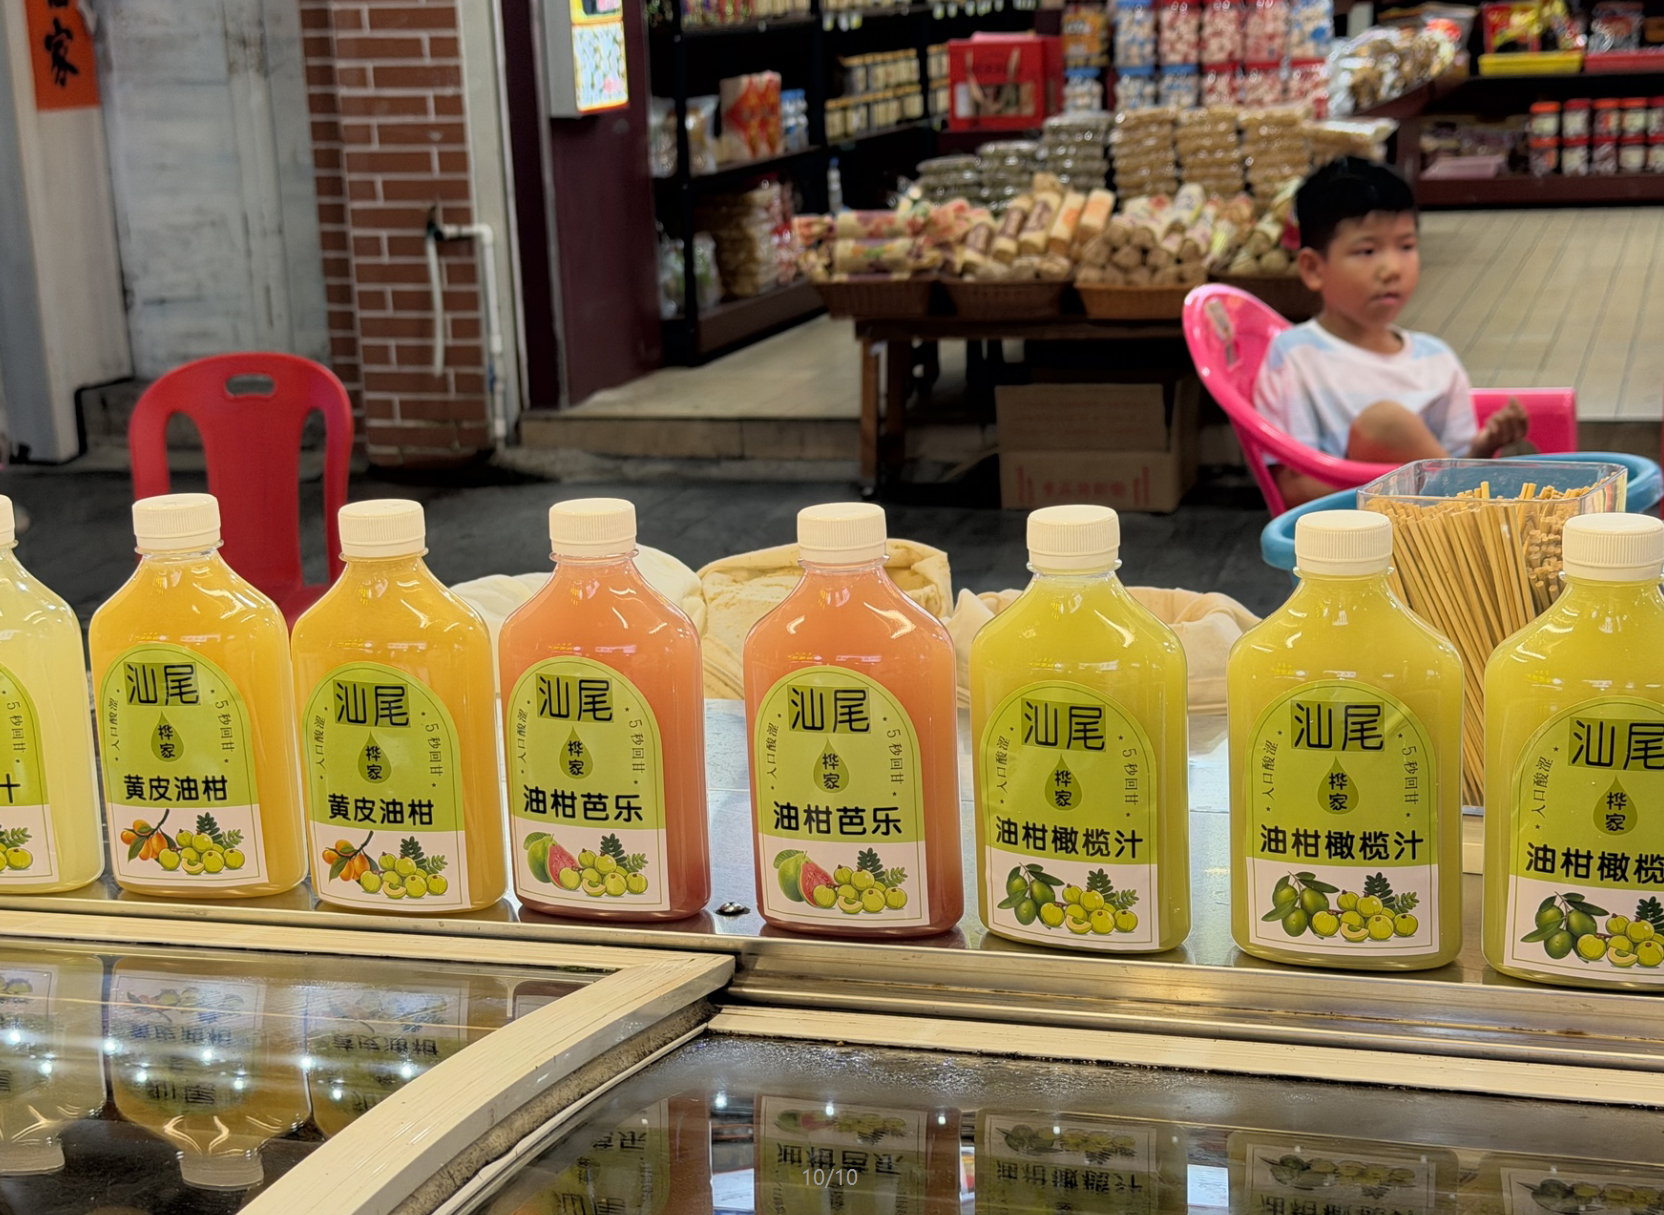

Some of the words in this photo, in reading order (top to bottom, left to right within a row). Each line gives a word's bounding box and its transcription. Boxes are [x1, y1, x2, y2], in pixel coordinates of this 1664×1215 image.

[44, 0, 79, 88] 家
[127, 664, 199, 705] 汕尾
[336, 682, 410, 727] 汕尾
[539, 676, 613, 722] 汕尾
[791, 687, 870, 733] 汕尾
[1024, 701, 1105, 751] 汕尾
[1294, 702, 1384, 751] 汕尾
[158, 724, 175, 759] 桦家
[365, 746, 382, 780] 桦家
[568, 740, 584, 776] 桦家
[887, 729, 904, 784] 5秒回甘
[1571, 720, 1664, 770] 汕尾
[822, 753, 840, 790] 桦家
[996, 735, 1011, 794] 入口酸涩
[1122, 748, 1139, 806] 5秒回甘
[1261, 740, 1279, 801] 入口酸涩
[1402, 746, 1419, 805] 5秒回甘
[124, 774, 228, 801] 黄皮油柑
[523, 784, 643, 822] 油柑芭乐
[1054, 770, 1072, 807] 桦家
[1328, 772, 1348, 811] 桦家
[1531, 756, 1554, 818] 入口酸涩
[328, 793, 434, 826] 黄皮油柑
[773, 801, 902, 836] 油柑芭乐
[1605, 791, 1628, 832] 桦家
[996, 815, 1143, 859] 油柑橄榄汁
[1260, 824, 1424, 861] 油柑橄榄汁
